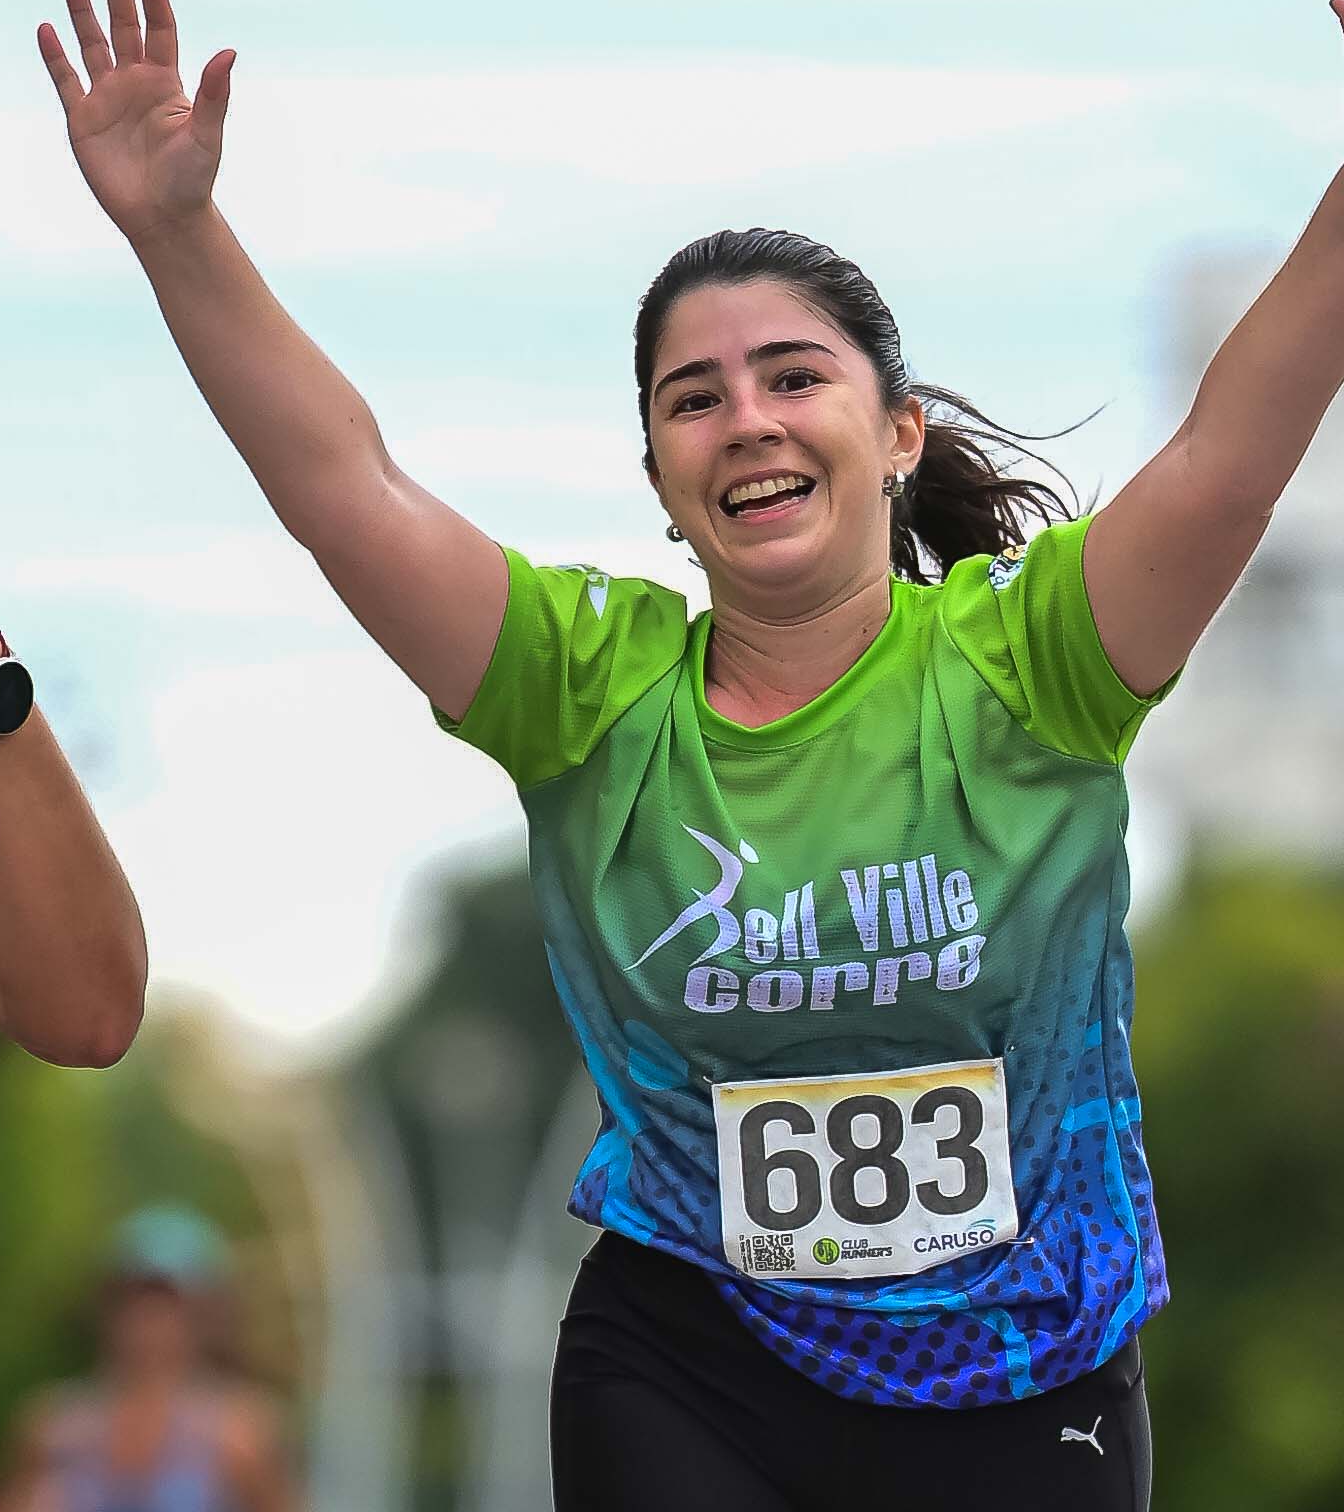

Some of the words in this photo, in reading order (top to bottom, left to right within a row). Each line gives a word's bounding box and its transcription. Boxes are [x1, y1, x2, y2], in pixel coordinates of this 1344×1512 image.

[840, 854, 980, 952] Ville
[683, 934, 987, 1013] corre
[739, 1086, 989, 1232] 683
[841, 1238, 869, 1250] CLUB
[913, 1228, 995, 1254] CARUSO
